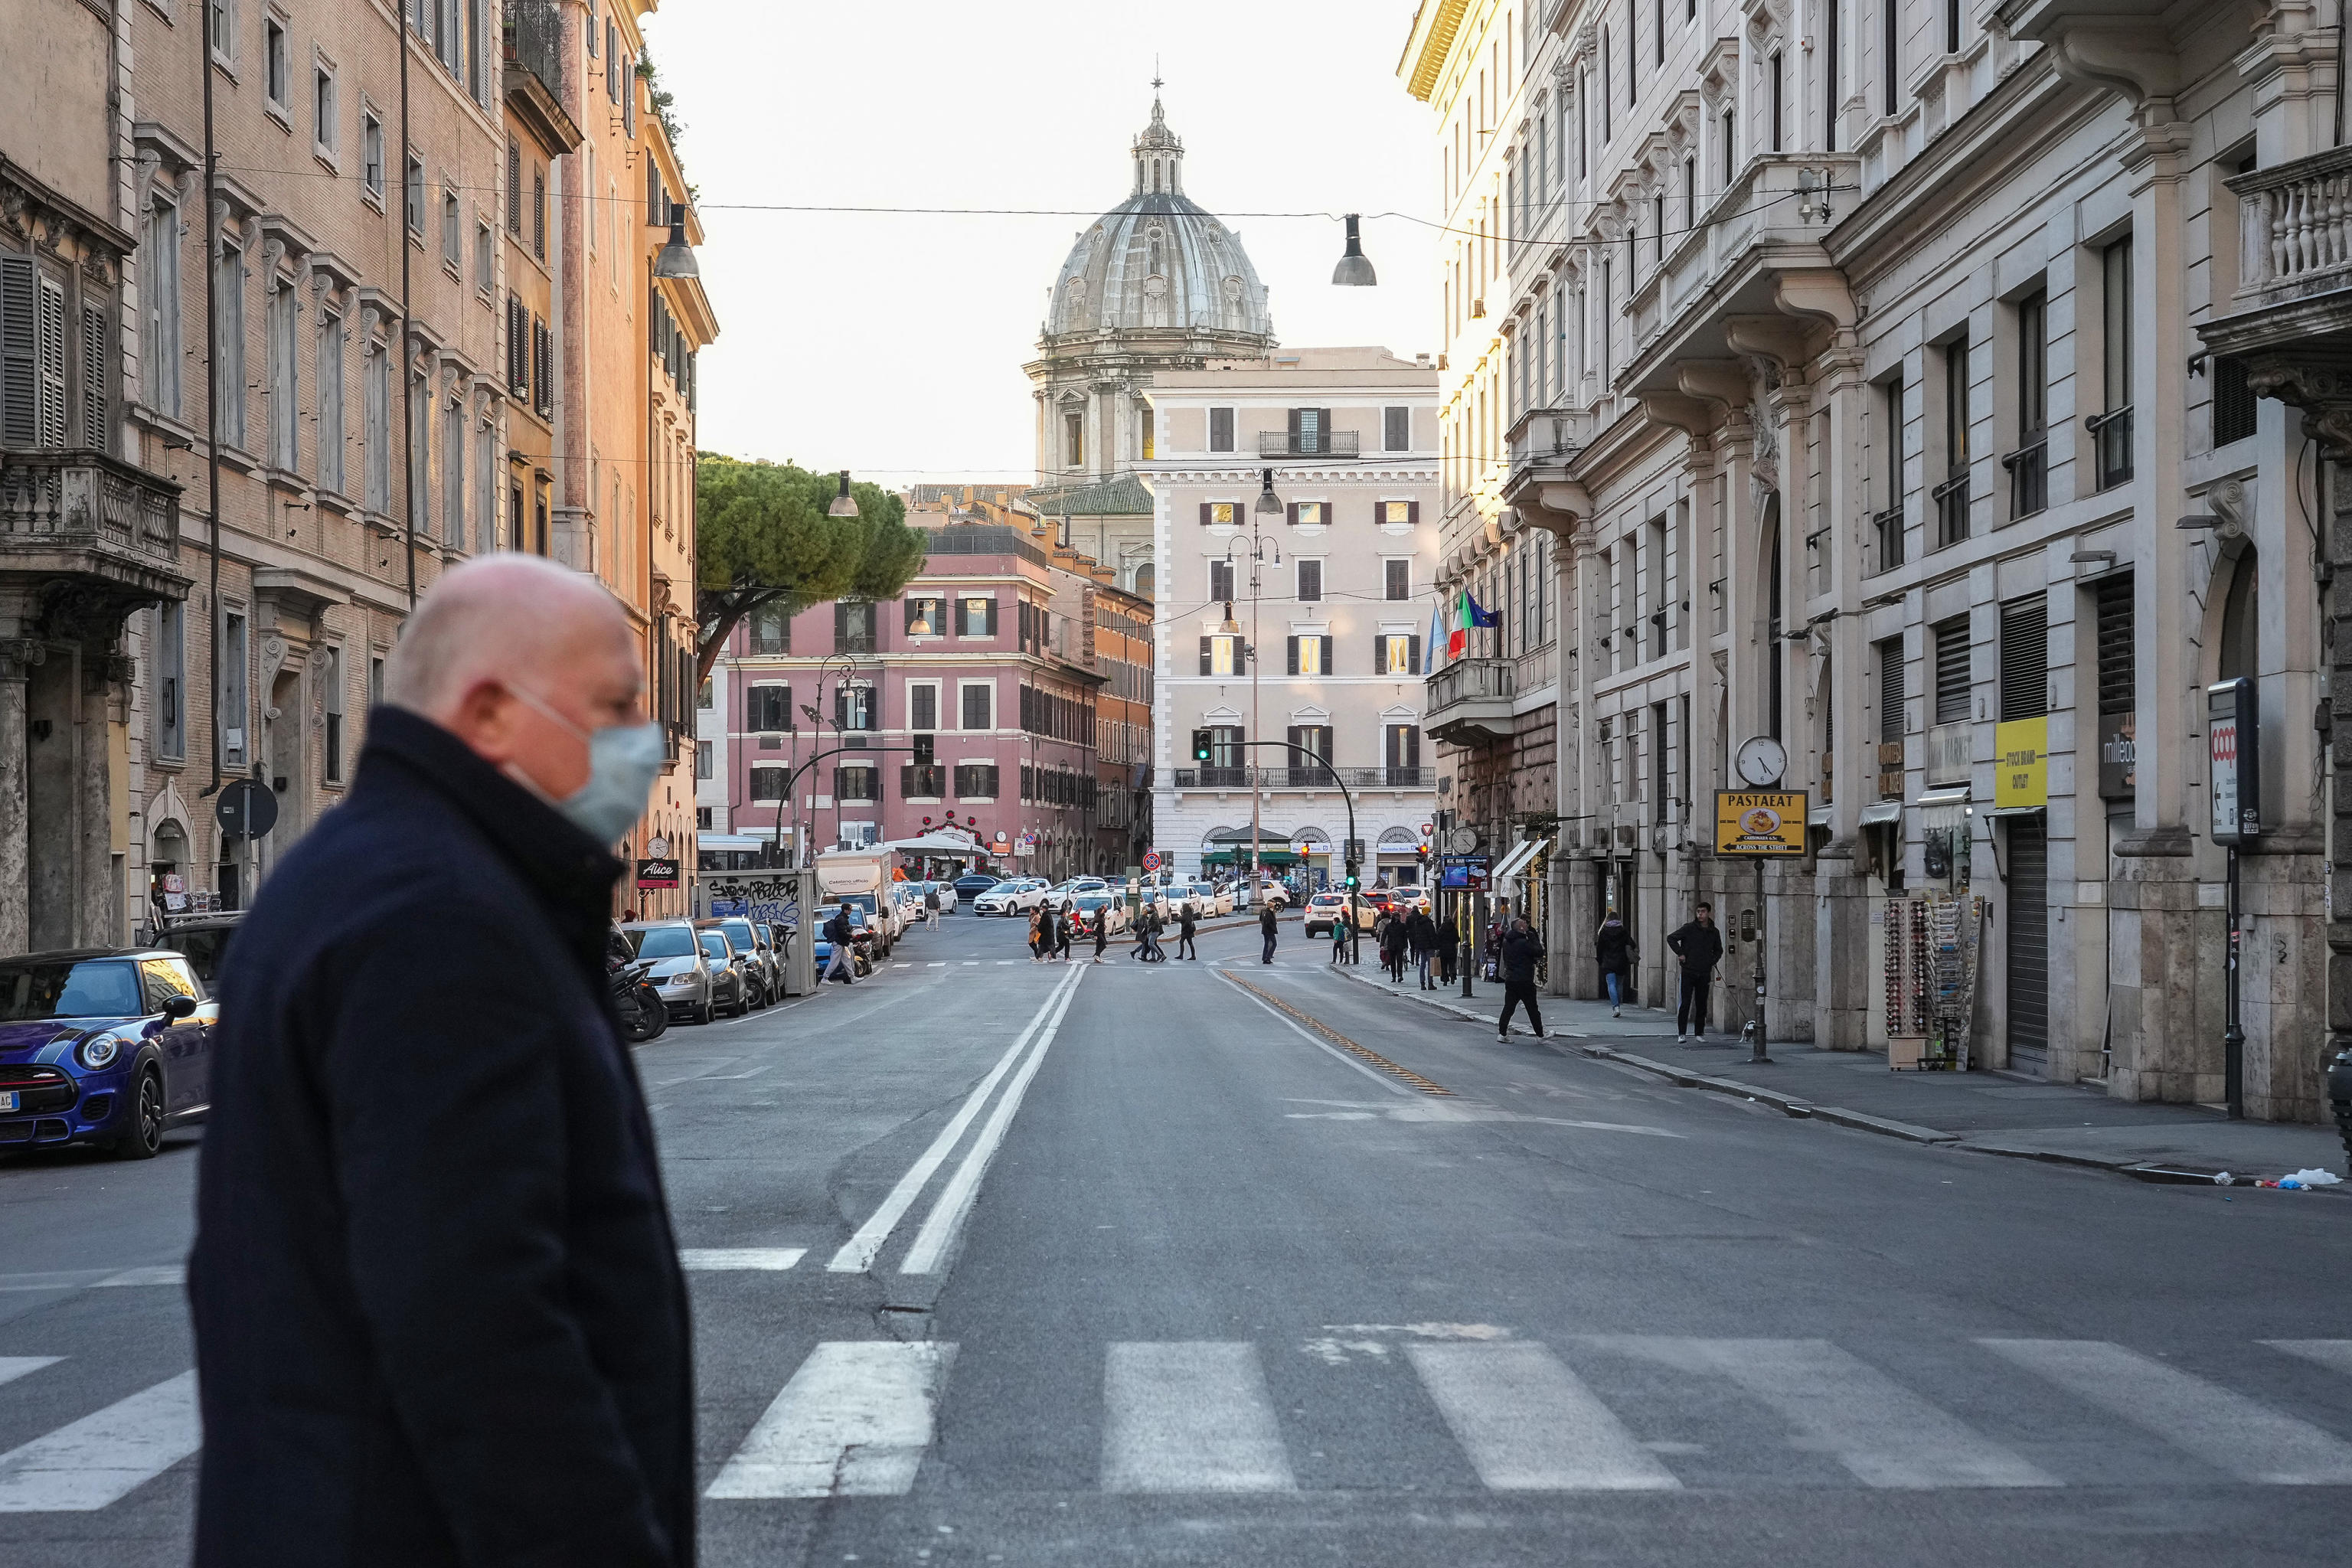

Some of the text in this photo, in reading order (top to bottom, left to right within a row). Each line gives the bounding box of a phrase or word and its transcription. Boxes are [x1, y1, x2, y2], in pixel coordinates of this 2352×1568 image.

[1945, 735, 1972, 766] MARKET
[2213, 727, 2236, 769] coop
[2007, 750, 2036, 767] STOCK BRAND
[2013, 773, 2029, 789] OUTLET
[1728, 795, 1793, 807] PASTAEAT
[642, 862, 673, 875] Alice
